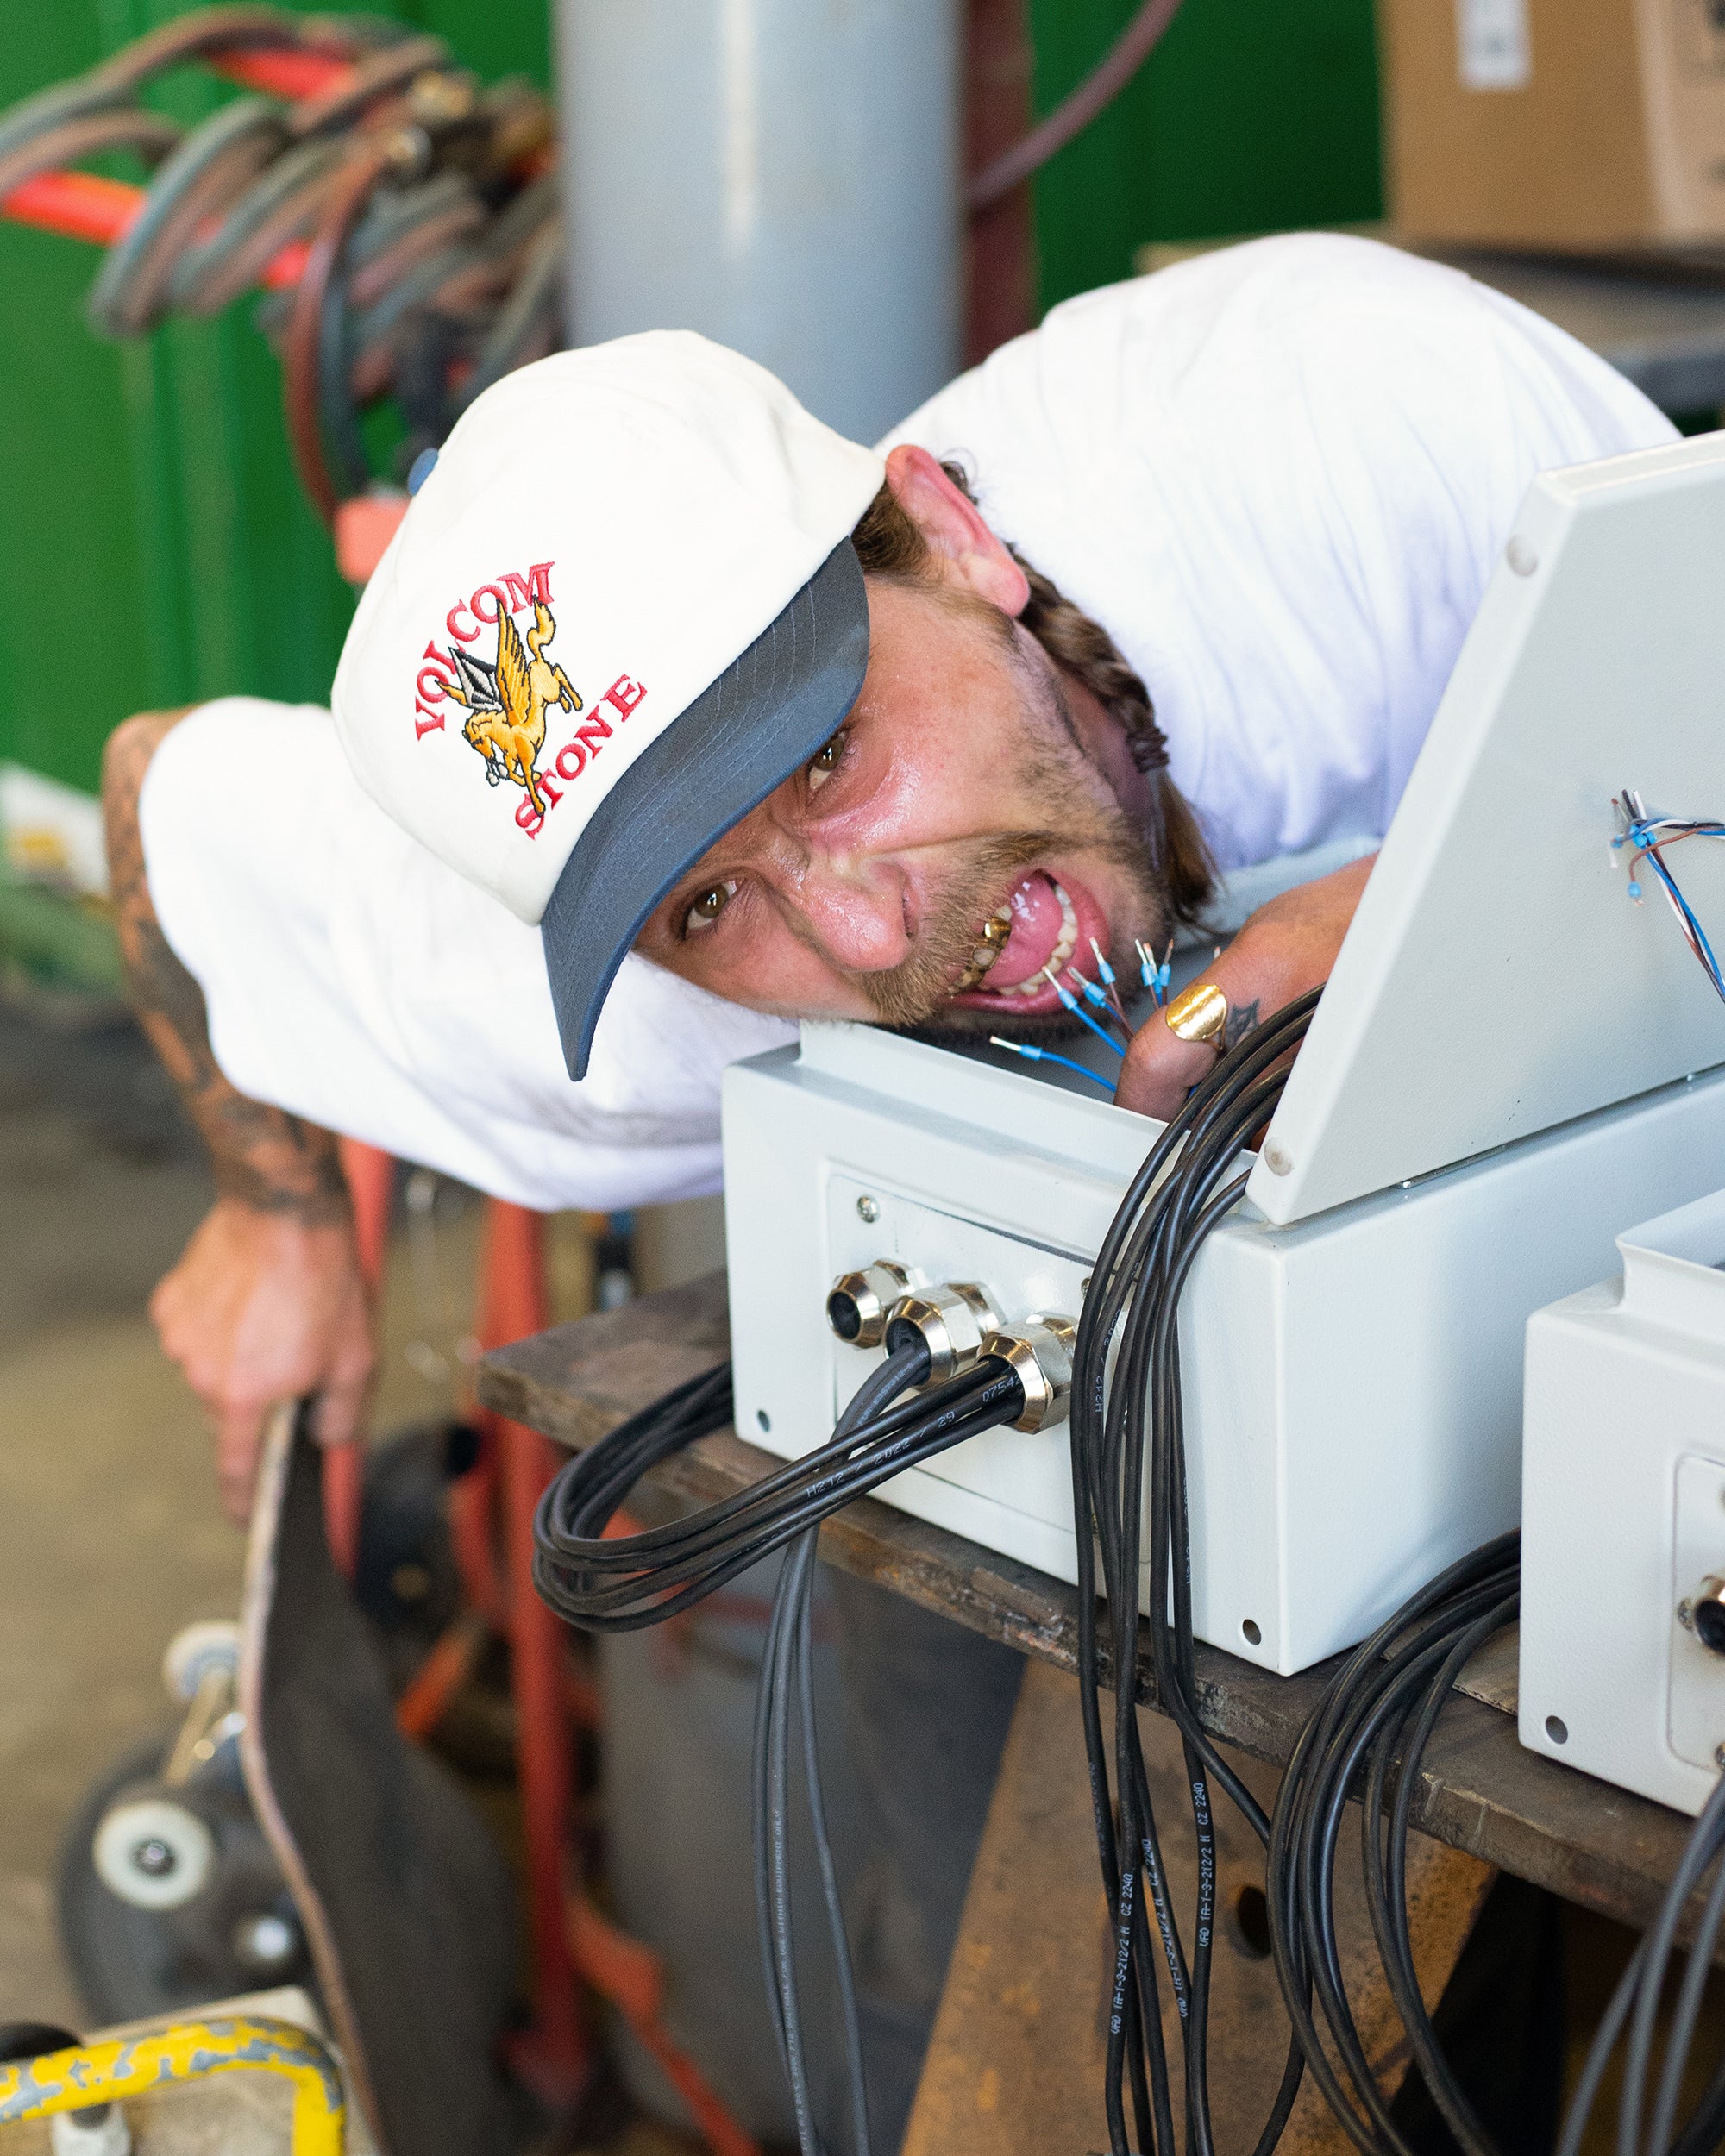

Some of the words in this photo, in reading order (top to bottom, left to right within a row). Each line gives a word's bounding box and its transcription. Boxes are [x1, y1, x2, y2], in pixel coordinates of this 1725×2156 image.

[415, 561, 555, 741] VOLCOM
[515, 674, 648, 841] STONE
[806, 1471, 844, 1498] H212
[874, 1438, 911, 1465] 2022
[937, 1411, 955, 1428] 29
[1194, 1783, 1206, 1807] 2240
[1198, 1812, 1208, 1826] CZ
[1122, 1873, 1133, 1898] 2240
[1121, 1903, 1132, 1916] CZ
